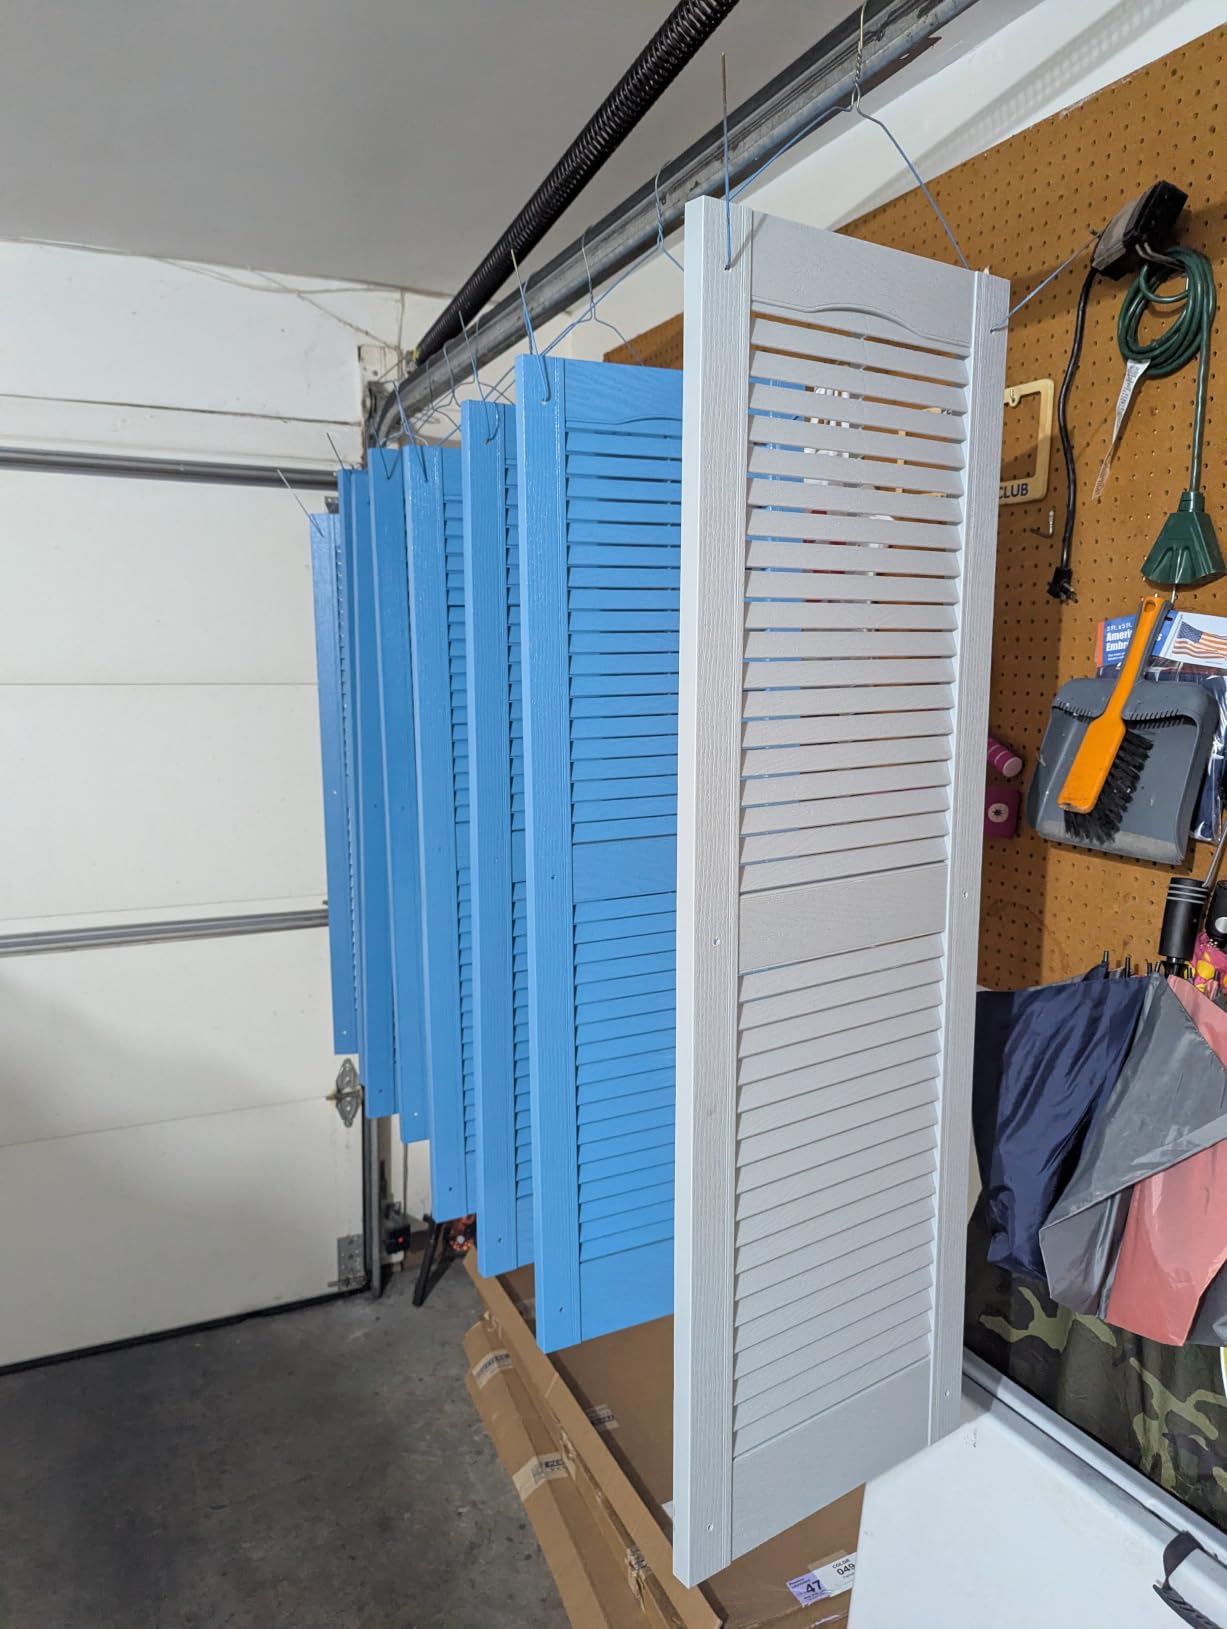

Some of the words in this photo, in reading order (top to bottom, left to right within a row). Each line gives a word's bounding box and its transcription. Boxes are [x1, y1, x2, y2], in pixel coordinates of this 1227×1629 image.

[1106, 629, 1133, 641] Ameri
[1106, 640, 1129, 652] Embr
[832, 1558, 851, 1569] COLOR
[806, 1579, 822, 1593] 47
